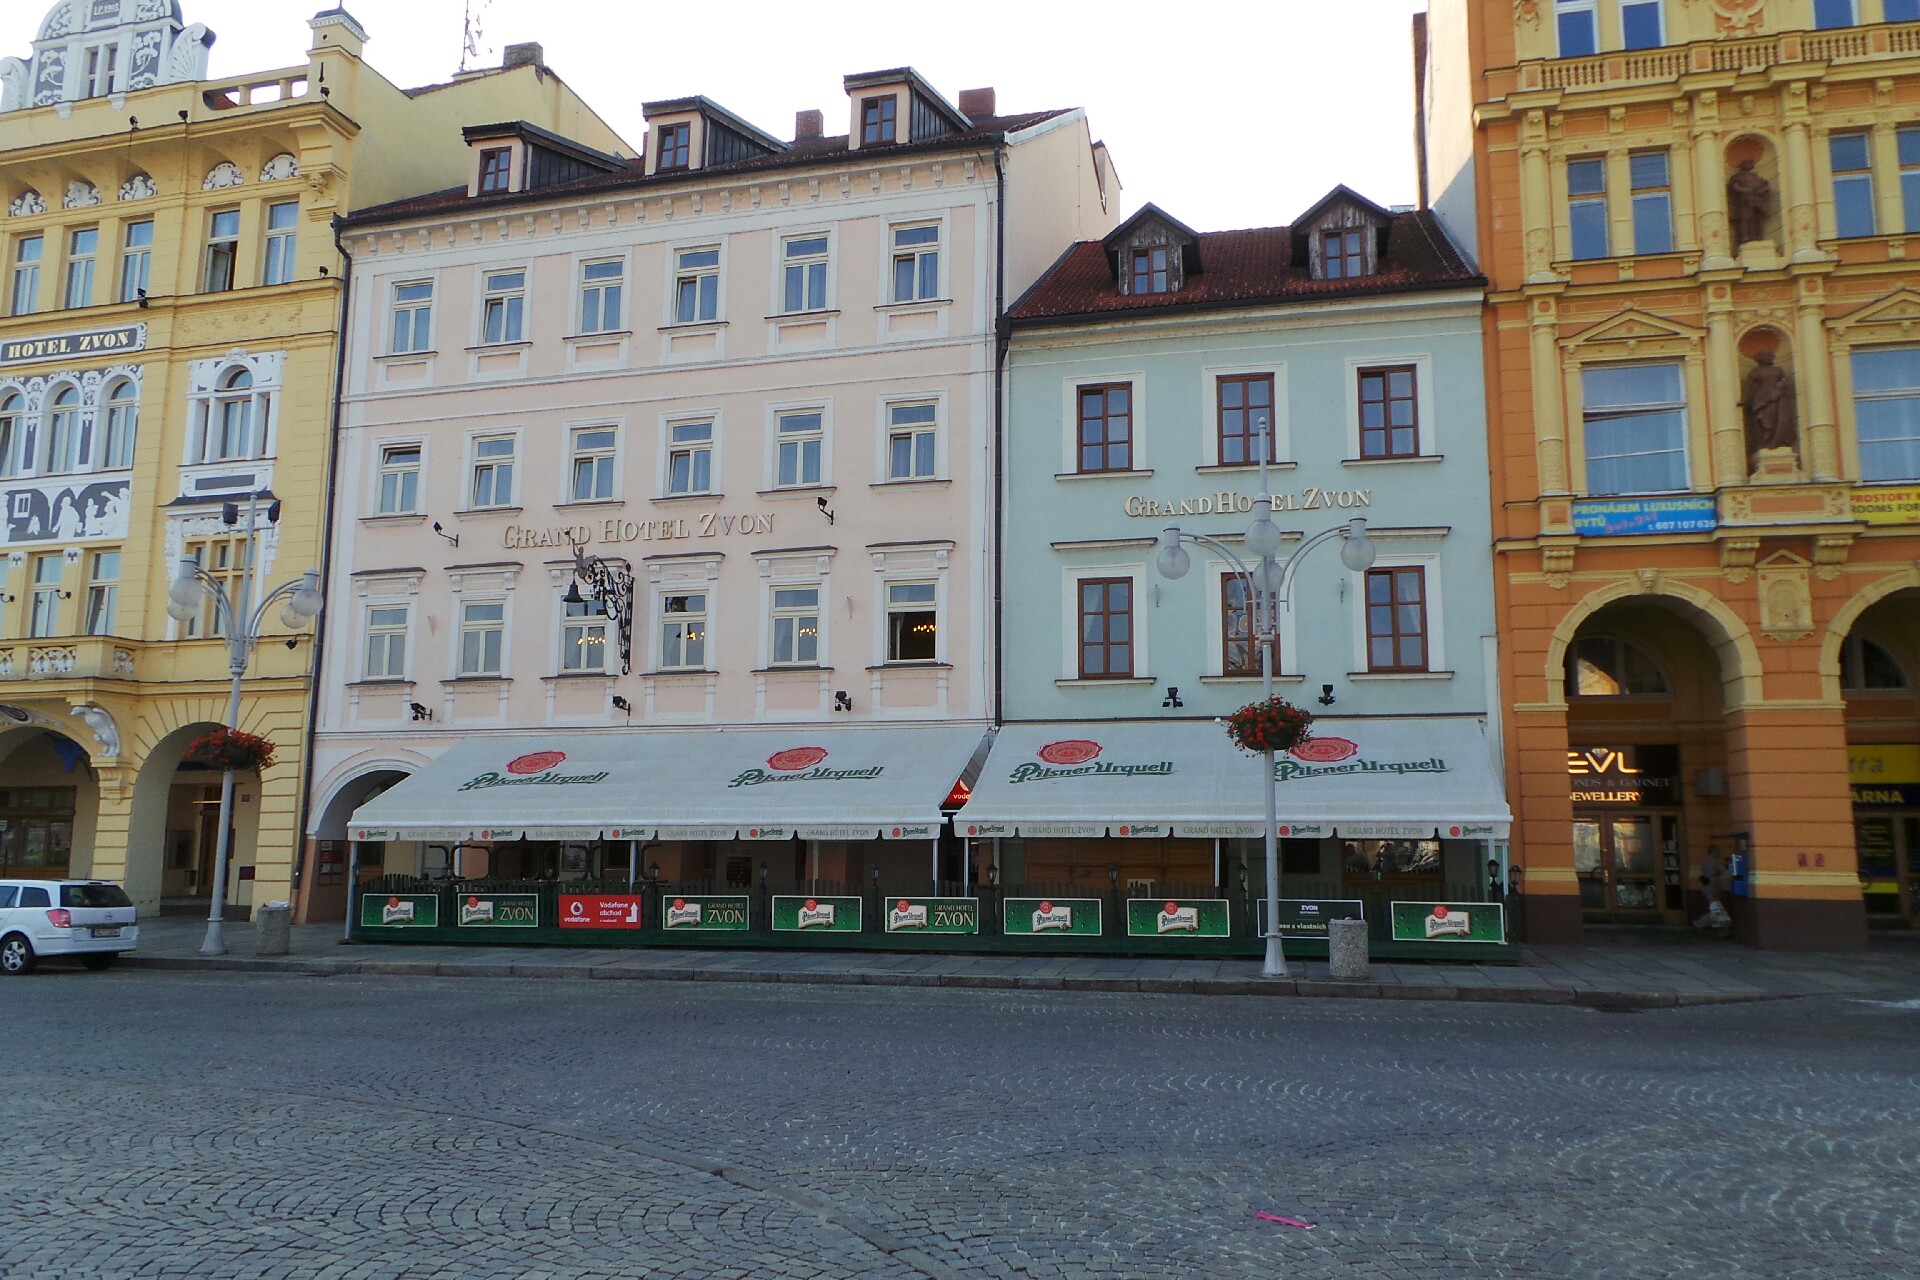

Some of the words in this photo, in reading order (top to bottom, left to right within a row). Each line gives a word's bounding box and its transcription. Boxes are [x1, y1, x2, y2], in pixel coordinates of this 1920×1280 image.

[8, 339, 70, 358] HOTEL
[79, 332, 130, 350] ZVON
[1125, 495, 1213, 517] GRAND
[1214, 491, 1299, 513] HOEL
[1302, 487, 1371, 510] ZVON
[1573, 502, 1640, 514] PRONÁJEM
[503, 524, 591, 549] GRAND
[598, 519, 689, 543] HOTEL
[698, 512, 775, 537] ZVON
[727, 769, 812, 788] Pilsner
[811, 766, 885, 781] Urquell
[1009, 762, 1095, 783] Pilsner
[1094, 761, 1174, 777] Urquell
[1275, 760, 1359, 782] Pilsner
[1358, 758, 1446, 774] Urquell
[457, 772, 541, 791] Pilsner
[541, 772, 610, 785] Urquell
[1621, 778, 1670, 787] GARNET
[1570, 791, 1643, 801] EWELLERY
[1347, 827, 1373, 835] GRAND
[1376, 827, 1399, 835] HOTEL
[1402, 827, 1423, 835] ZVON
[500, 907, 533, 920] ZVON
[707, 910, 745, 923] ZVON
[934, 912, 974, 926] ZVON
[1297, 922, 1326, 930] vlastních
